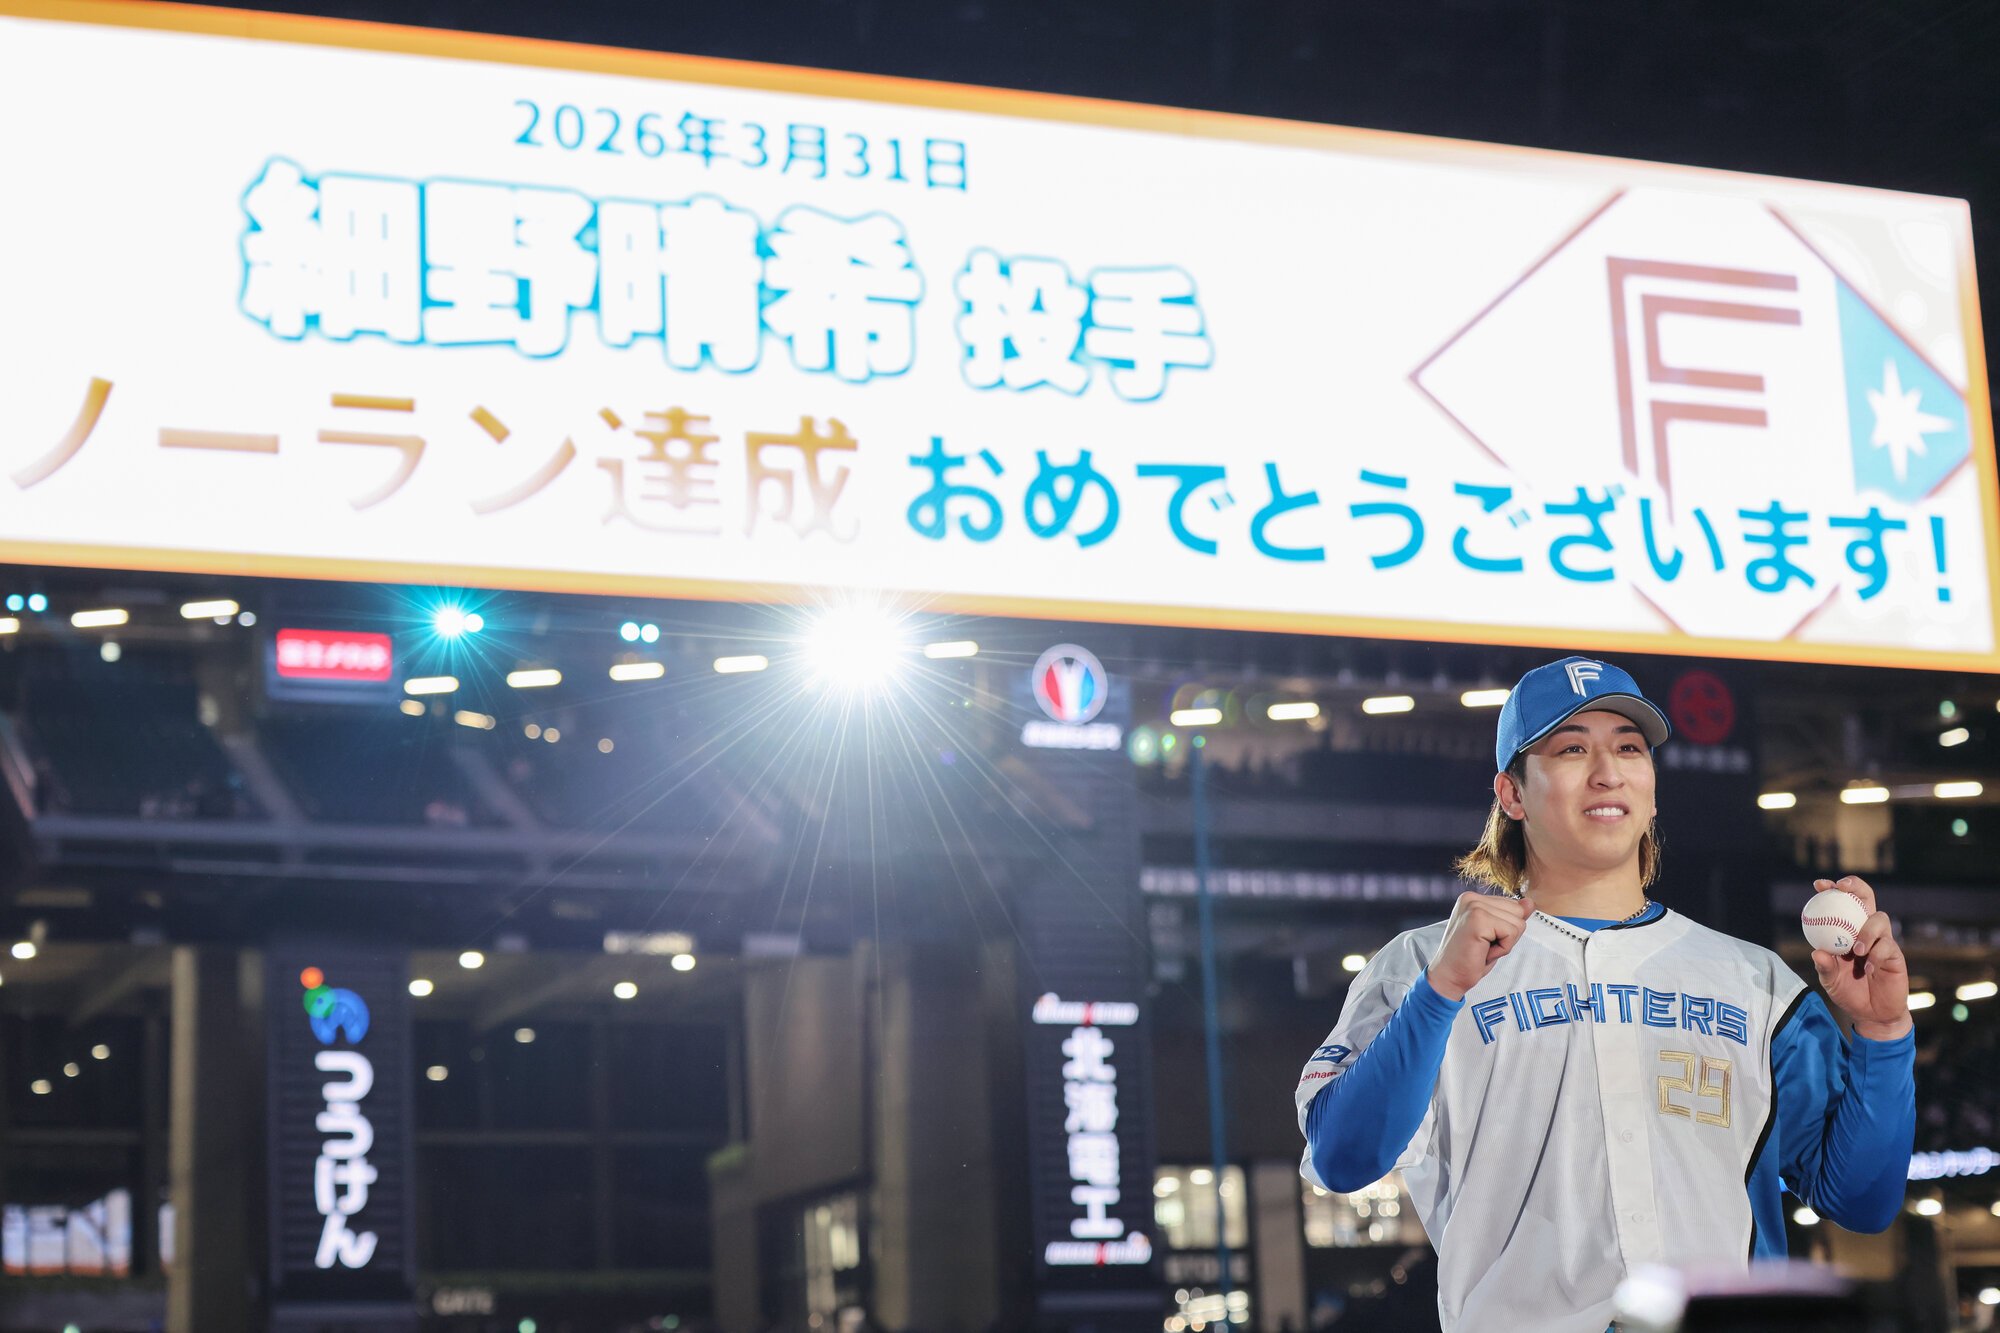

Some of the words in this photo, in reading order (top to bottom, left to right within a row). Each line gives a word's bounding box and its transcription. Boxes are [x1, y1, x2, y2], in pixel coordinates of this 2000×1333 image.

[513, 99, 969, 193] 2026年3月31日
[952, 245, 1215, 403] 投手
[1605, 255, 1803, 527] F
[10, 375, 861, 545] ノーラン達成
[1564, 661, 1604, 698] F
[1470, 982, 1749, 1047] FIGHTERS
[1300, 1071, 1338, 1082] onham
[1657, 1049, 1733, 1129] 29
[314, 1050, 379, 1269] つうけん
